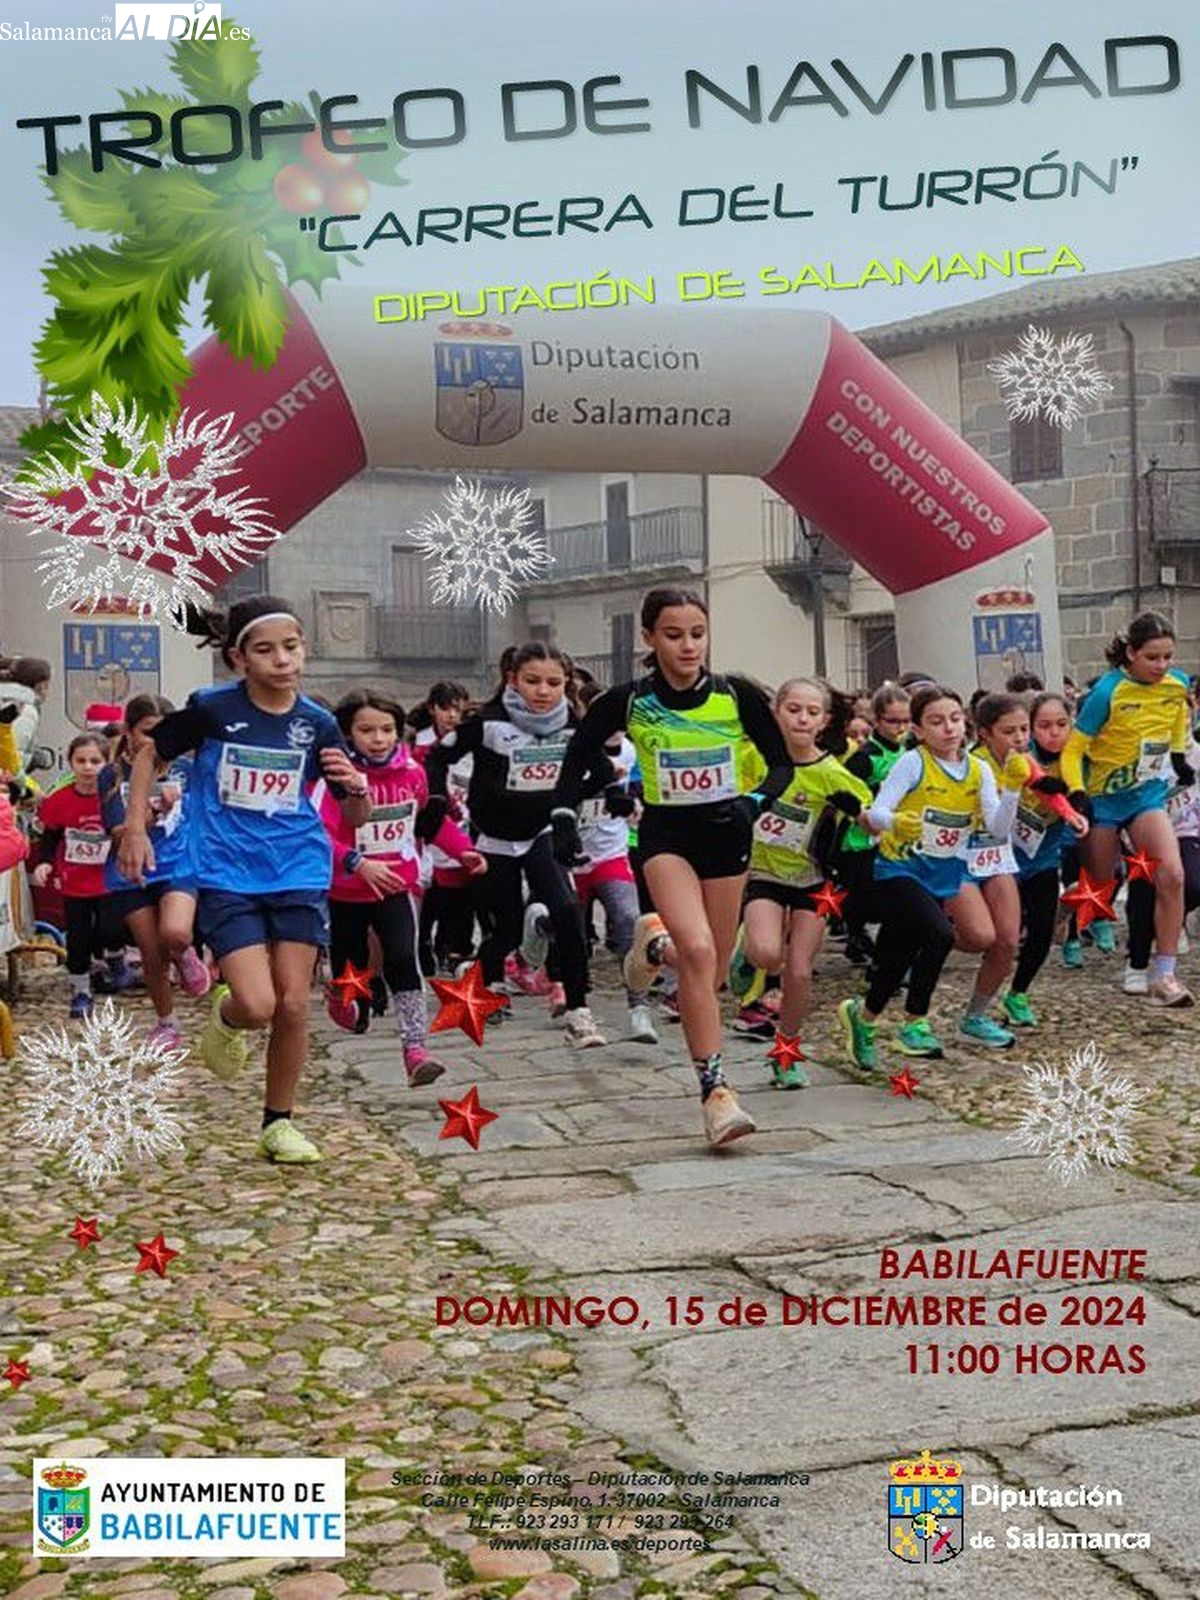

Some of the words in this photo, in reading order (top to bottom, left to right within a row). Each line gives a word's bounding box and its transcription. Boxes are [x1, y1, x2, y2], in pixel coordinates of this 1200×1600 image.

[531, 340, 700, 373] Diputación
[222, 364, 336, 459] EPORTE
[531, 403, 559, 424] de
[572, 397, 732, 426] Salamanca
[840, 379, 892, 429] CON
[890, 425, 1007, 535] NUESTROS
[826, 411, 977, 551] DEPORTISTAS
[232, 768, 290, 796] 1199
[522, 762, 558, 780] 652
[668, 766, 722, 791] 1061
[373, 821, 406, 842] 169
[760, 815, 787, 837] 62
[936, 829, 960, 847] 38
